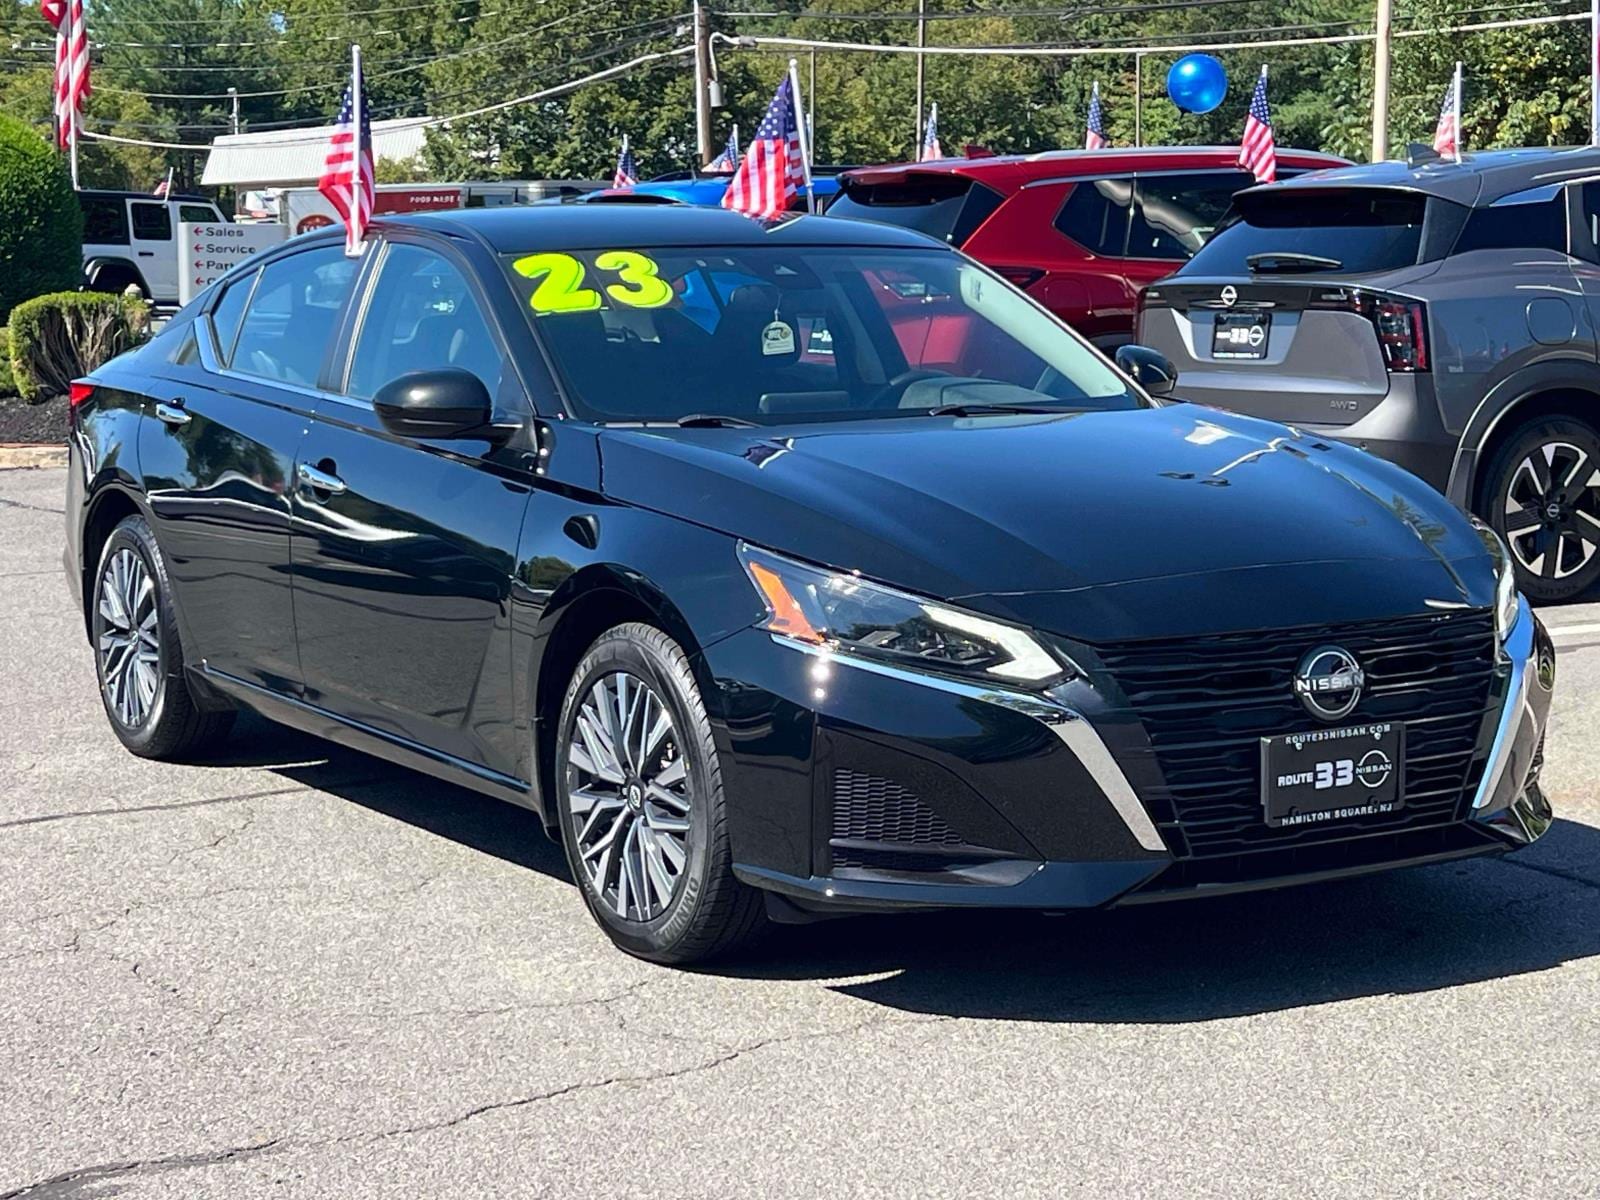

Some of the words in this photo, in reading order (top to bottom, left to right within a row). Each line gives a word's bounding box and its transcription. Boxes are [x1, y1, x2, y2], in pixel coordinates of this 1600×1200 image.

[206, 227, 244, 237] Sales
[206, 244, 256, 254] Service
[512, 251, 674, 313] 23
[1329, 400, 1358, 410] AWD
[1296, 669, 1365, 691] NISSAN
[1277, 772, 1314, 787] ROUTE
[1315, 759, 1354, 789] 33
[1355, 763, 1392, 774] NISSAN
[1281, 810, 1331, 826] HAMILTON
[1379, 803, 1393, 812] NJ
